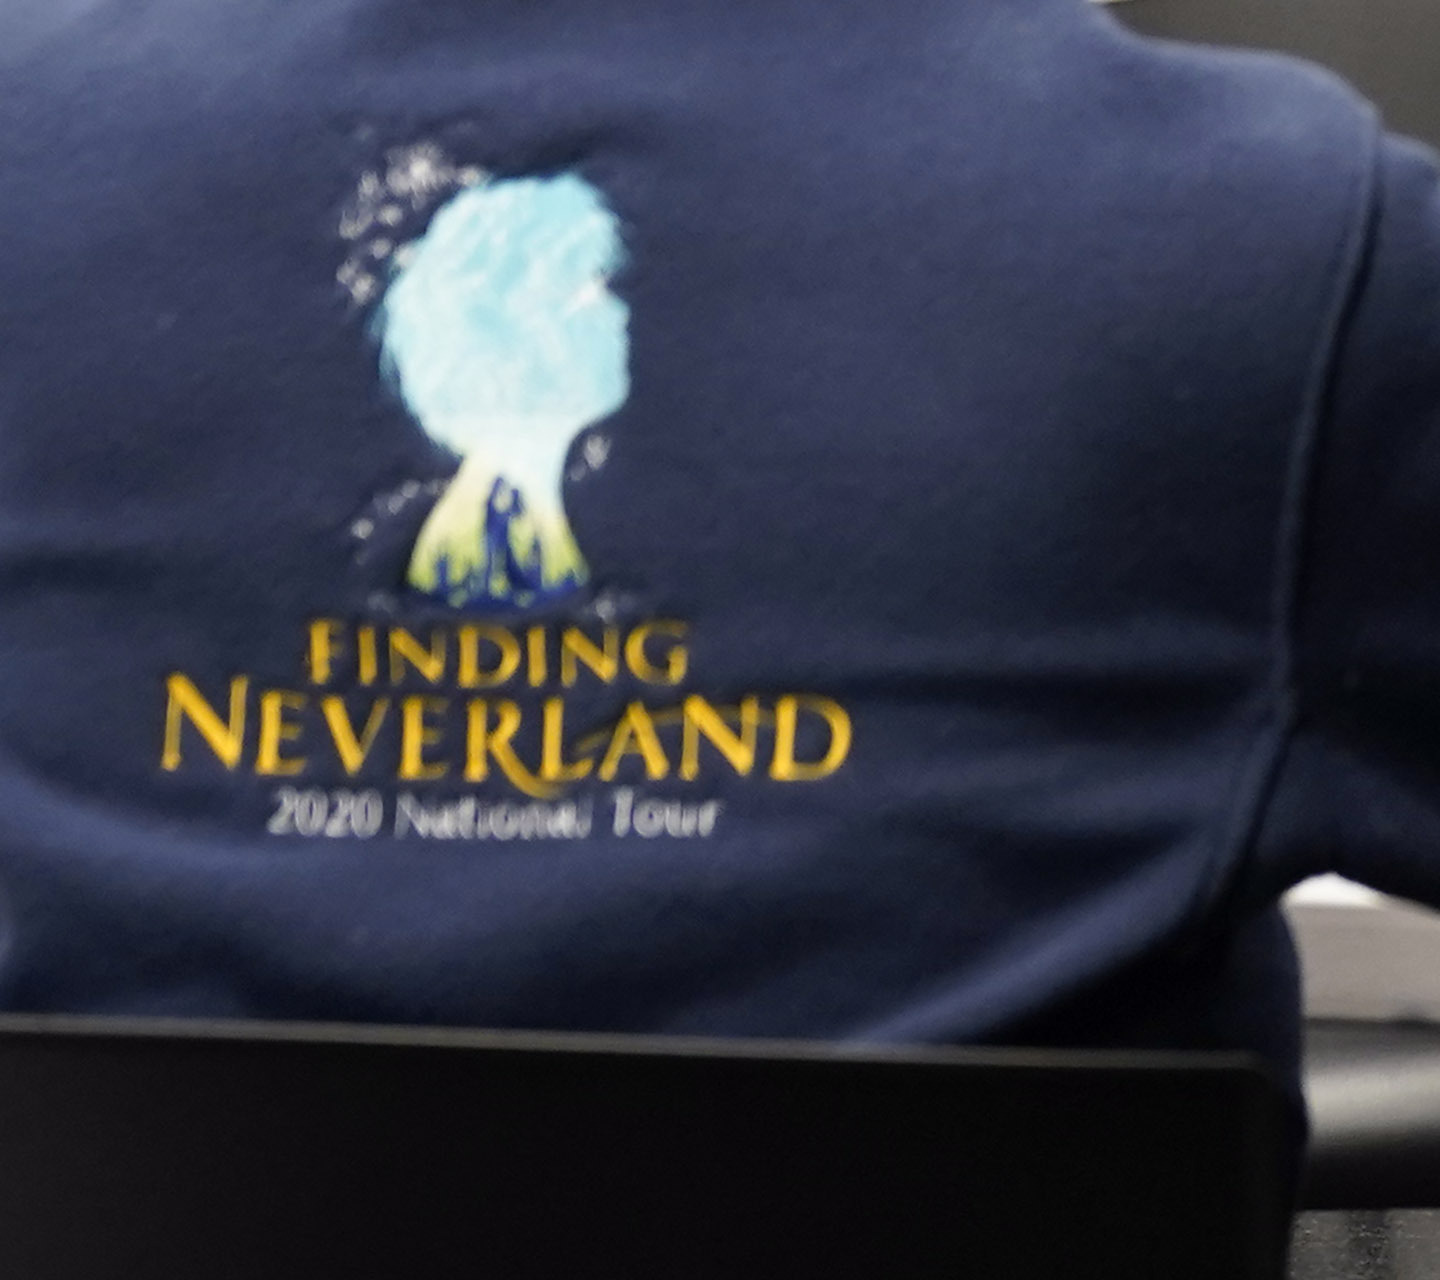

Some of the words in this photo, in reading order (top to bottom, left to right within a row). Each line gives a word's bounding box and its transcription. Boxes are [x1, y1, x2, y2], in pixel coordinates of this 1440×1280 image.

[306, 618, 691, 688] FINDING
[267, 786, 384, 838] 2020
[394, 790, 593, 841] National
[610, 790, 726, 838] Tour
